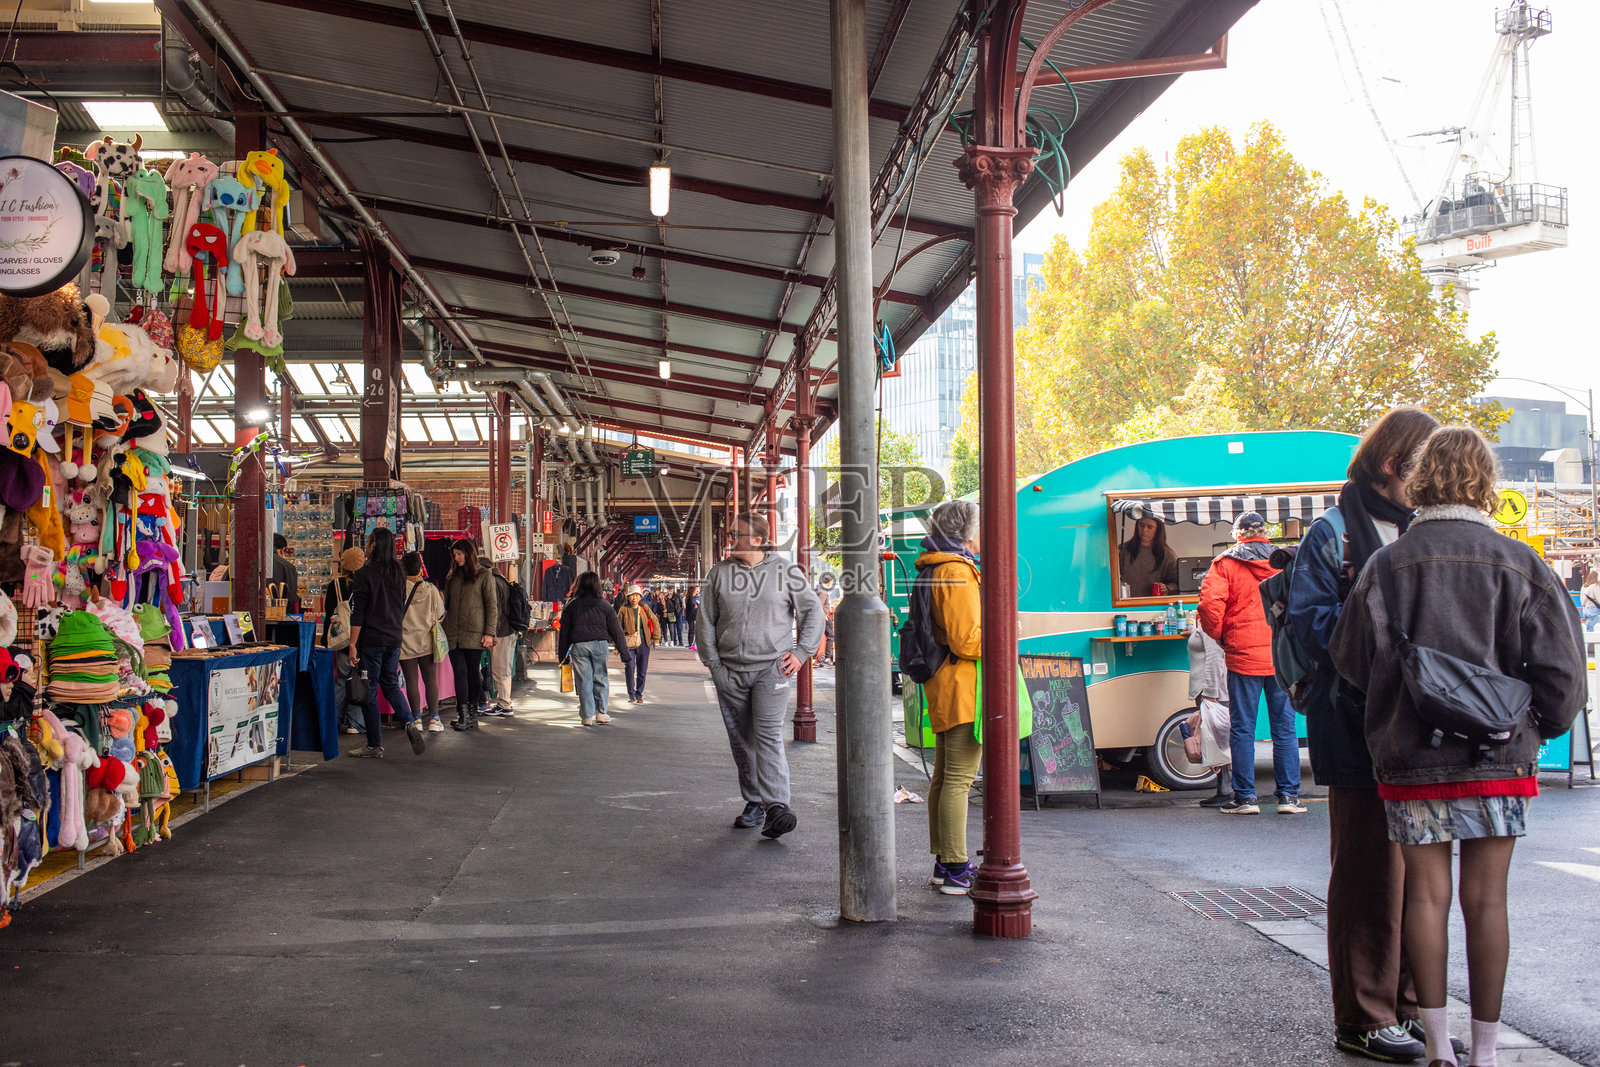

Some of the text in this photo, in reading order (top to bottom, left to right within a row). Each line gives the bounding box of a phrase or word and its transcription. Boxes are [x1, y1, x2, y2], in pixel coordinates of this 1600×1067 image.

[19, 195, 55, 213] Fashion
[1466, 235, 1493, 252] Built
[33, 256, 63, 264] GLOVES
[0, 267, 40, 275] NGLASSES
[372, 367, 382, 381] Q
[370, 383, 384, 396] 26
[494, 525, 510, 533] END
[494, 552, 517, 560] AREA
[1021, 657, 1083, 679] MATCHA
